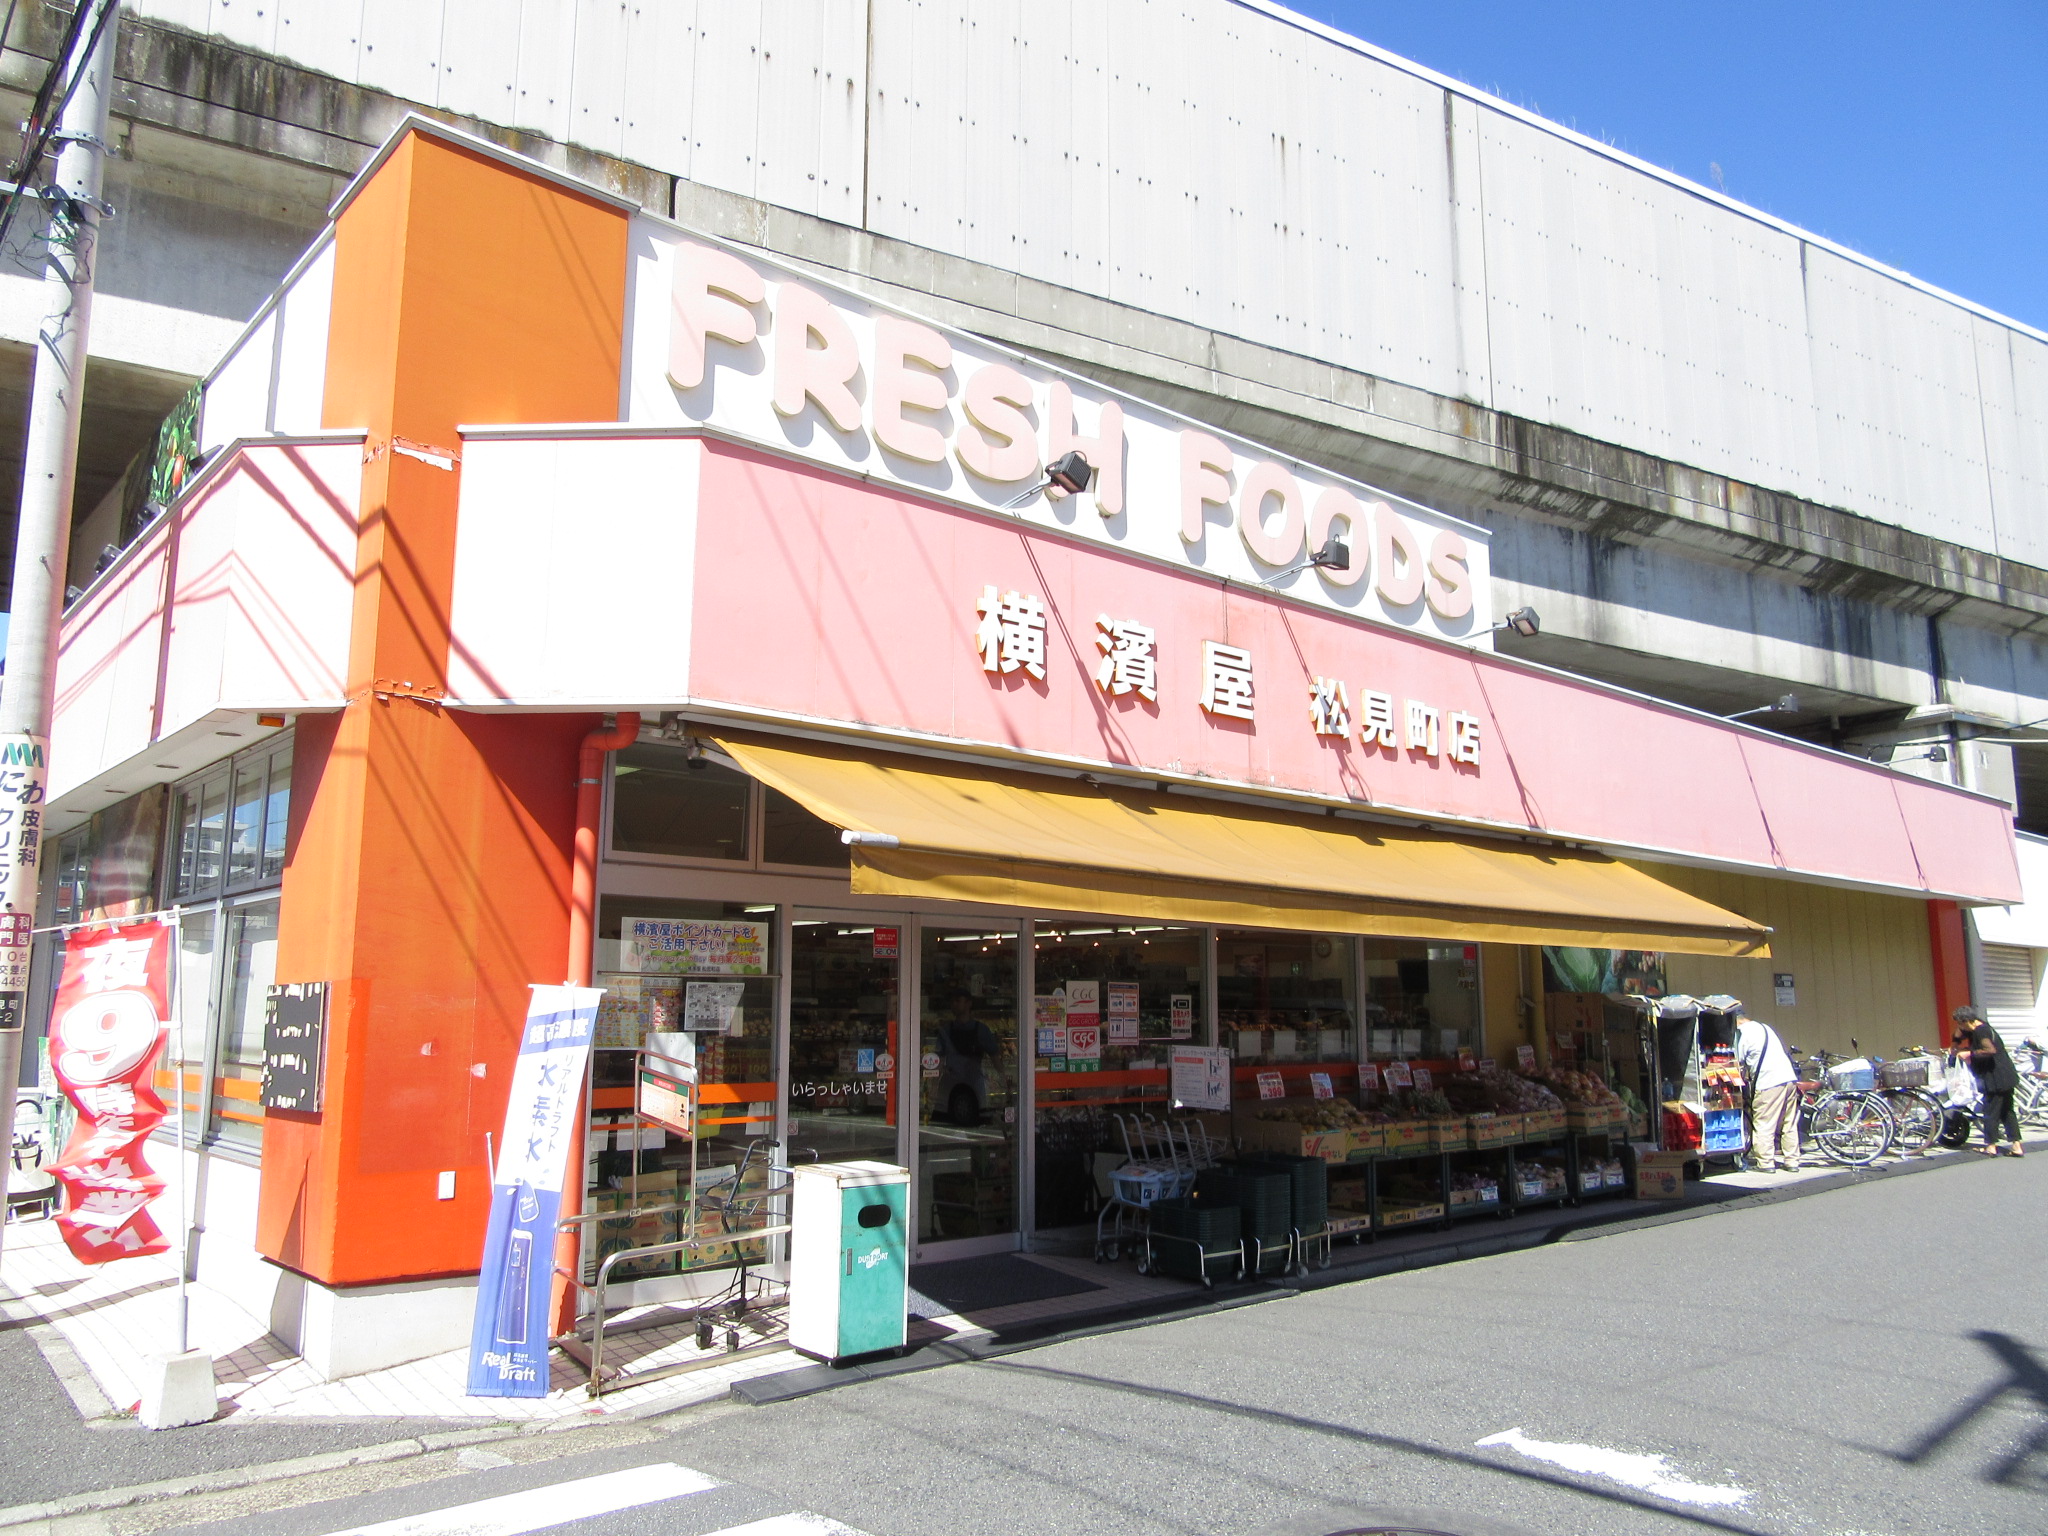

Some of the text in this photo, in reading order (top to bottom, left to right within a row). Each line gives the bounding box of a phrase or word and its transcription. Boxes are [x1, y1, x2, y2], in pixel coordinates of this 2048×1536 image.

[665, 242, 1476, 619] FRESH FOODS
[976, 585, 1482, 768] 横濱屋 松見町店
[17, 809, 41, 868] 皮膚科
[634, 922, 753, 939] 横濱屋ポイントカードを
[1072, 988, 1097, 1000] CGC
[1073, 1032, 1095, 1050] CGC
[792, 1081, 888, 1096] いらっしゃいませ
[481, 1352, 511, 1367] Real
[498, 1366, 537, 1382] Draft
